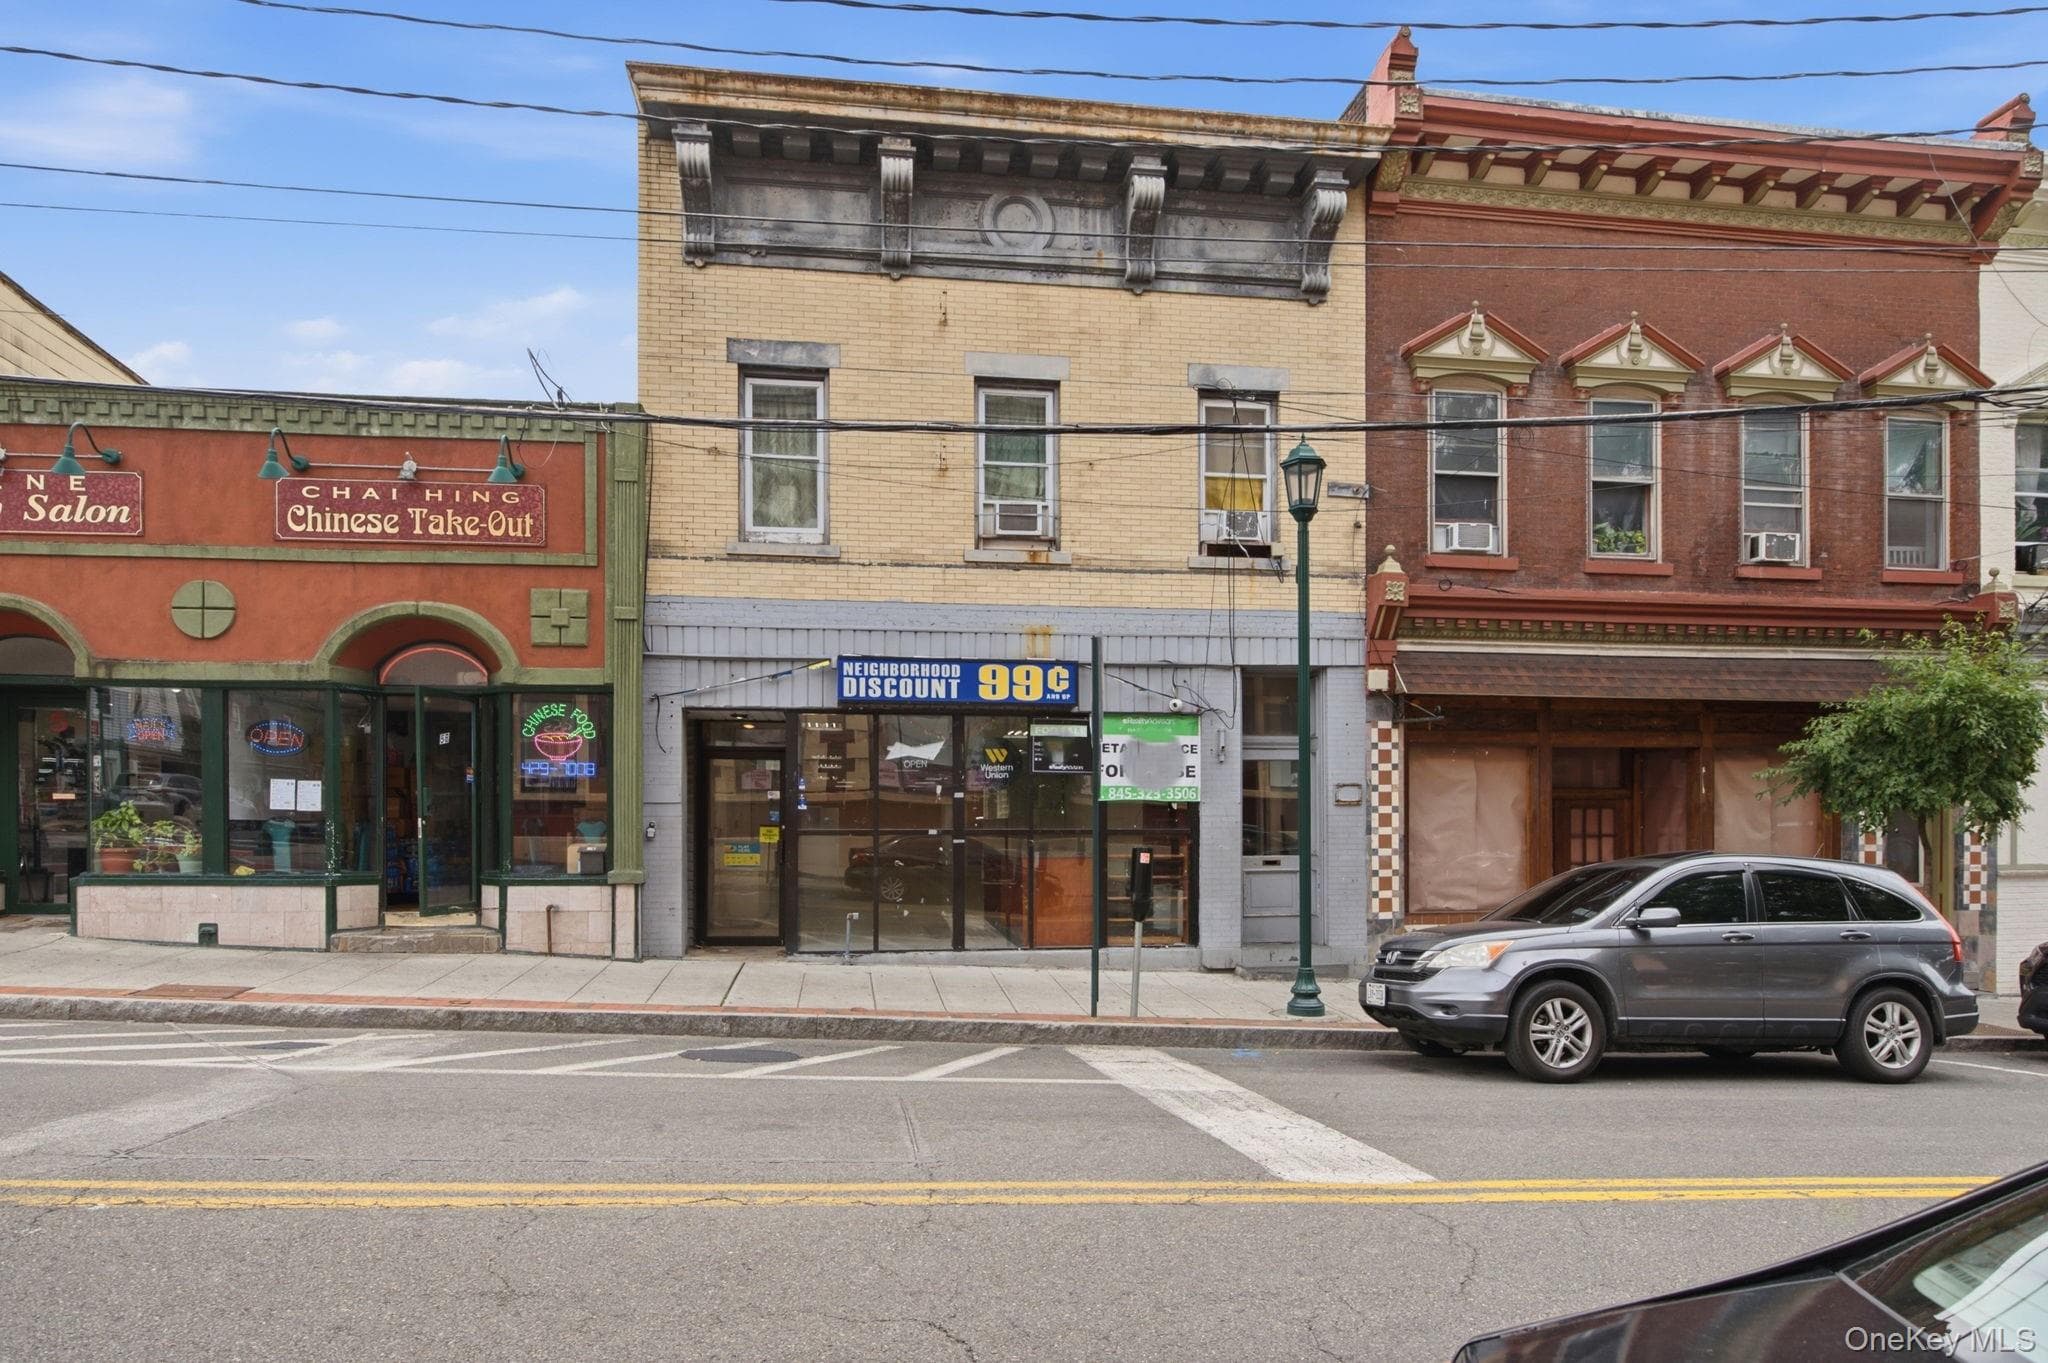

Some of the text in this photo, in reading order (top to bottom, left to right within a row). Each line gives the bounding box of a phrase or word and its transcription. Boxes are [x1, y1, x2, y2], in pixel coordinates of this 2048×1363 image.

[301, 486, 520, 504] CHAI HING
[23, 494, 131, 523] Salon
[287, 505, 534, 538] Chinese Take-Out
[843, 662, 960, 678] NEIGHBORHOOD
[843, 677, 960, 699] DISCOUNT
[522, 703, 596, 739] CHINESE FOOD
[250, 728, 305, 747] OPEN
[903, 759, 928, 768] OPEN
[980, 764, 1014, 772] Western
[985, 771, 1009, 779] Union
